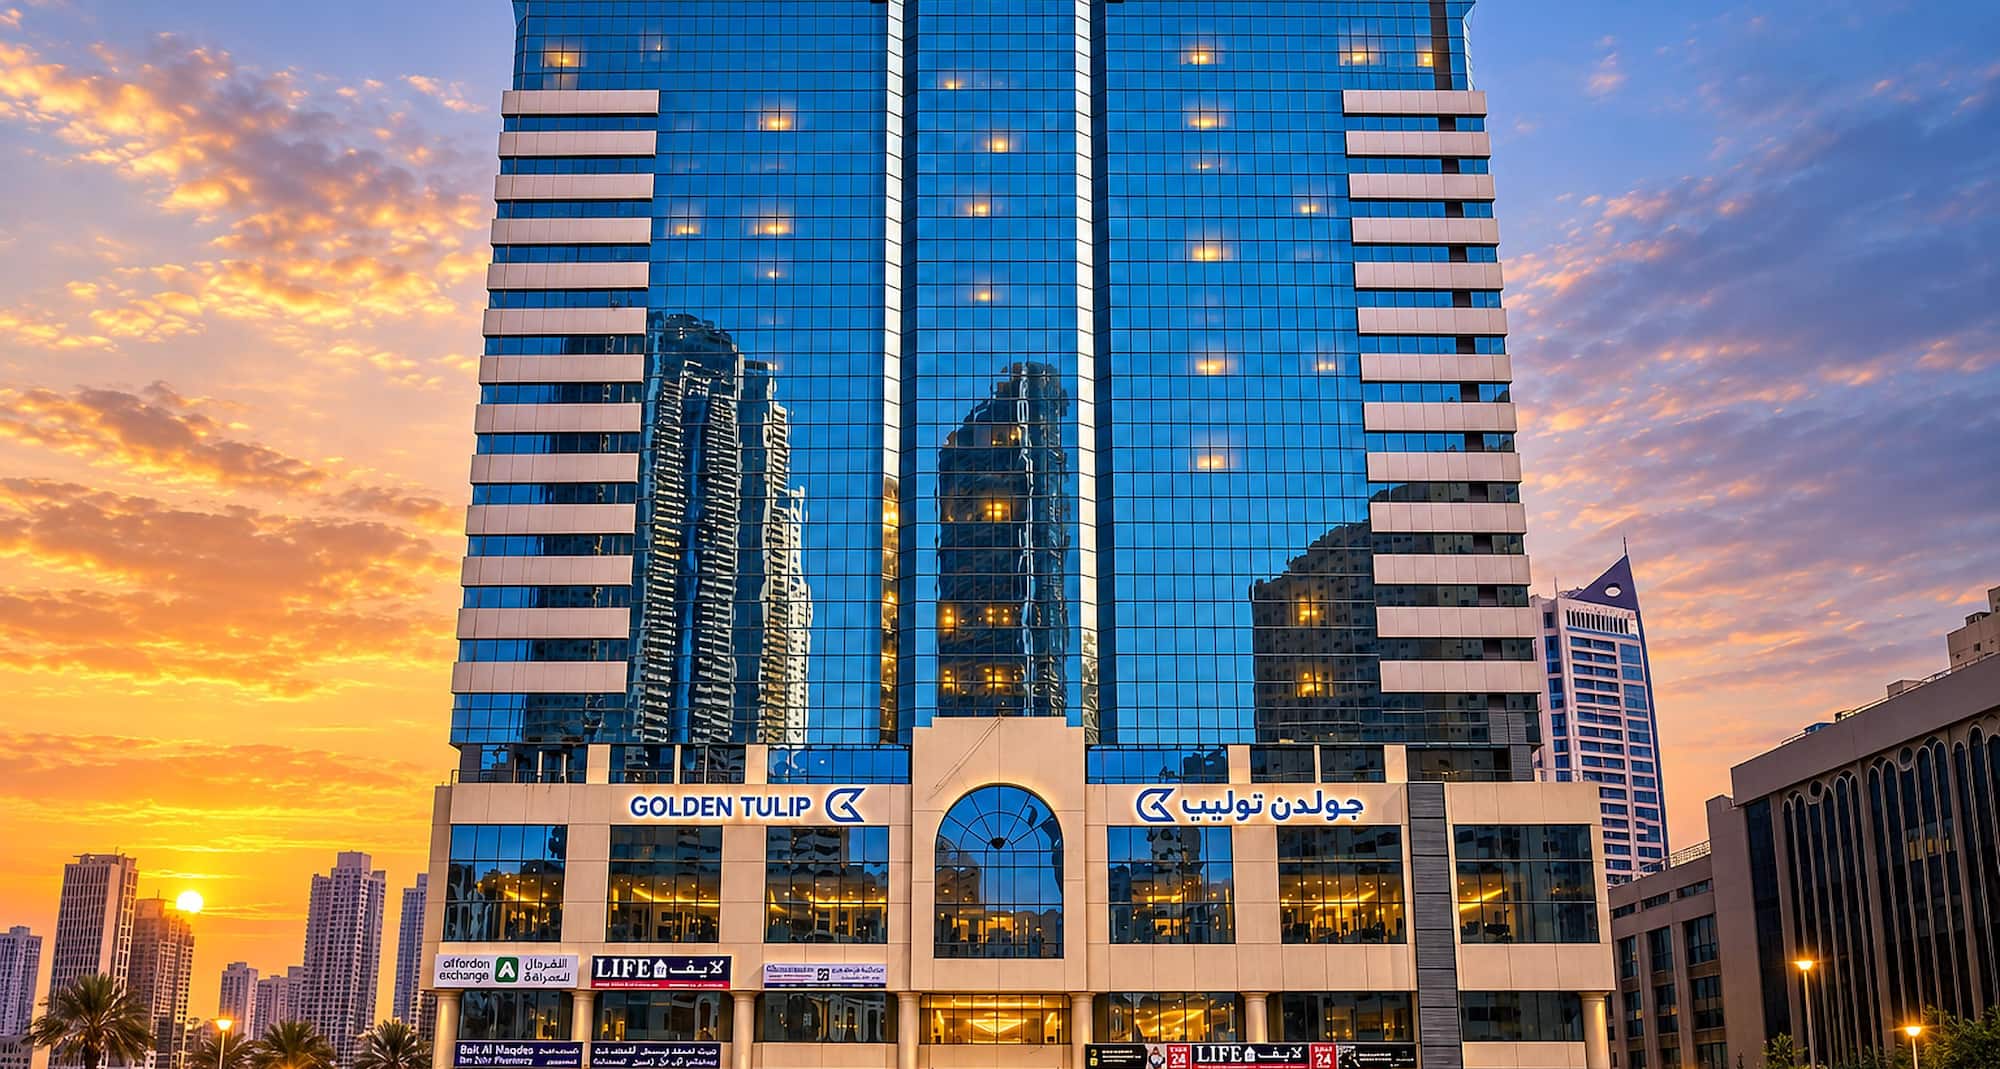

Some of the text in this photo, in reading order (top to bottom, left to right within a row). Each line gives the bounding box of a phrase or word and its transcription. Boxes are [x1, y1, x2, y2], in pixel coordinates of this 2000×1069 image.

[630, 795, 812, 818] GOLDEN TULIP
[1181, 790, 1365, 822] جولدن توليب
[439, 970, 489, 984] exchange
[595, 958, 652, 979] LIFE
[669, 959, 725, 979] لايف
[481, 1044, 493, 1055] Al
[1196, 1045, 1243, 1063] LIFE
[1257, 1046, 1303, 1063] لايف
[1170, 1053, 1187, 1065] 24
